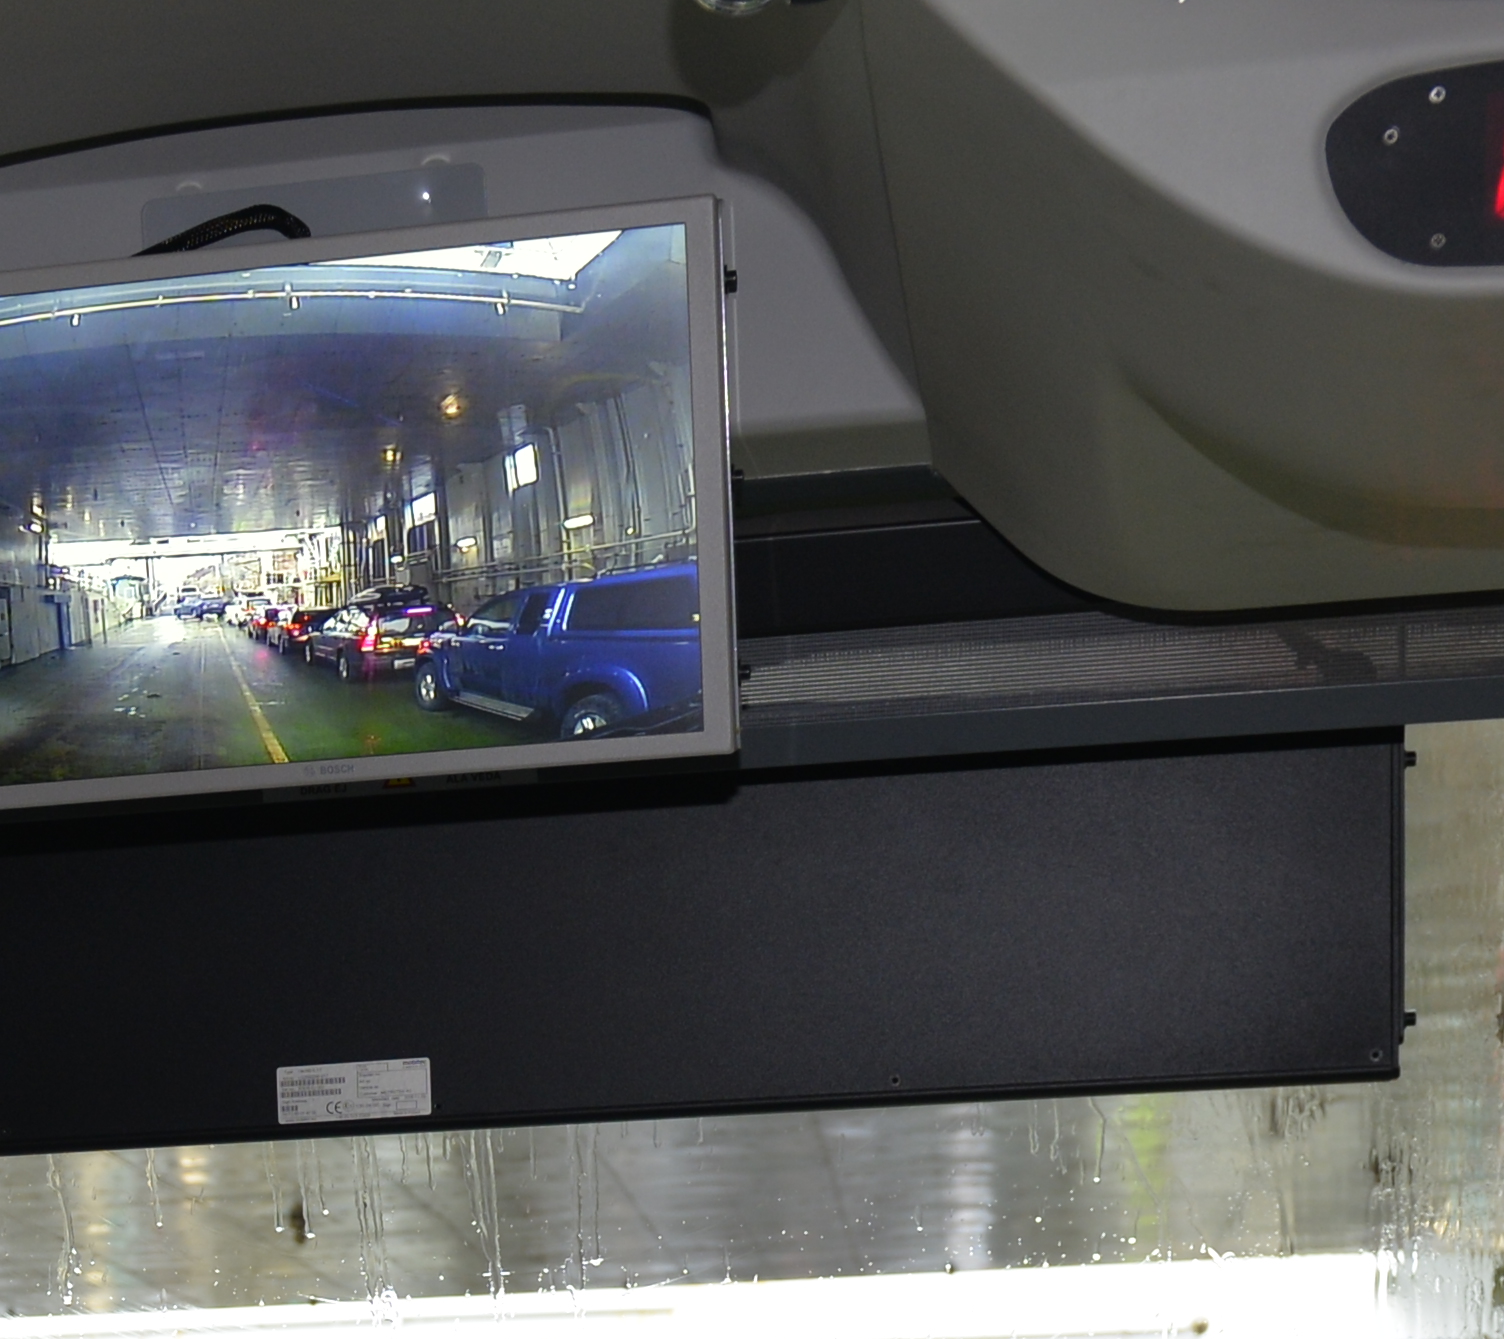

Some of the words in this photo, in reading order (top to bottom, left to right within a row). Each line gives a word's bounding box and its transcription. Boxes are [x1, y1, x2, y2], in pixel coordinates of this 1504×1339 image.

[319, 763, 354, 775] BOSCH
[300, 784, 331, 796] DRAG
[334, 783, 347, 794] EJ
